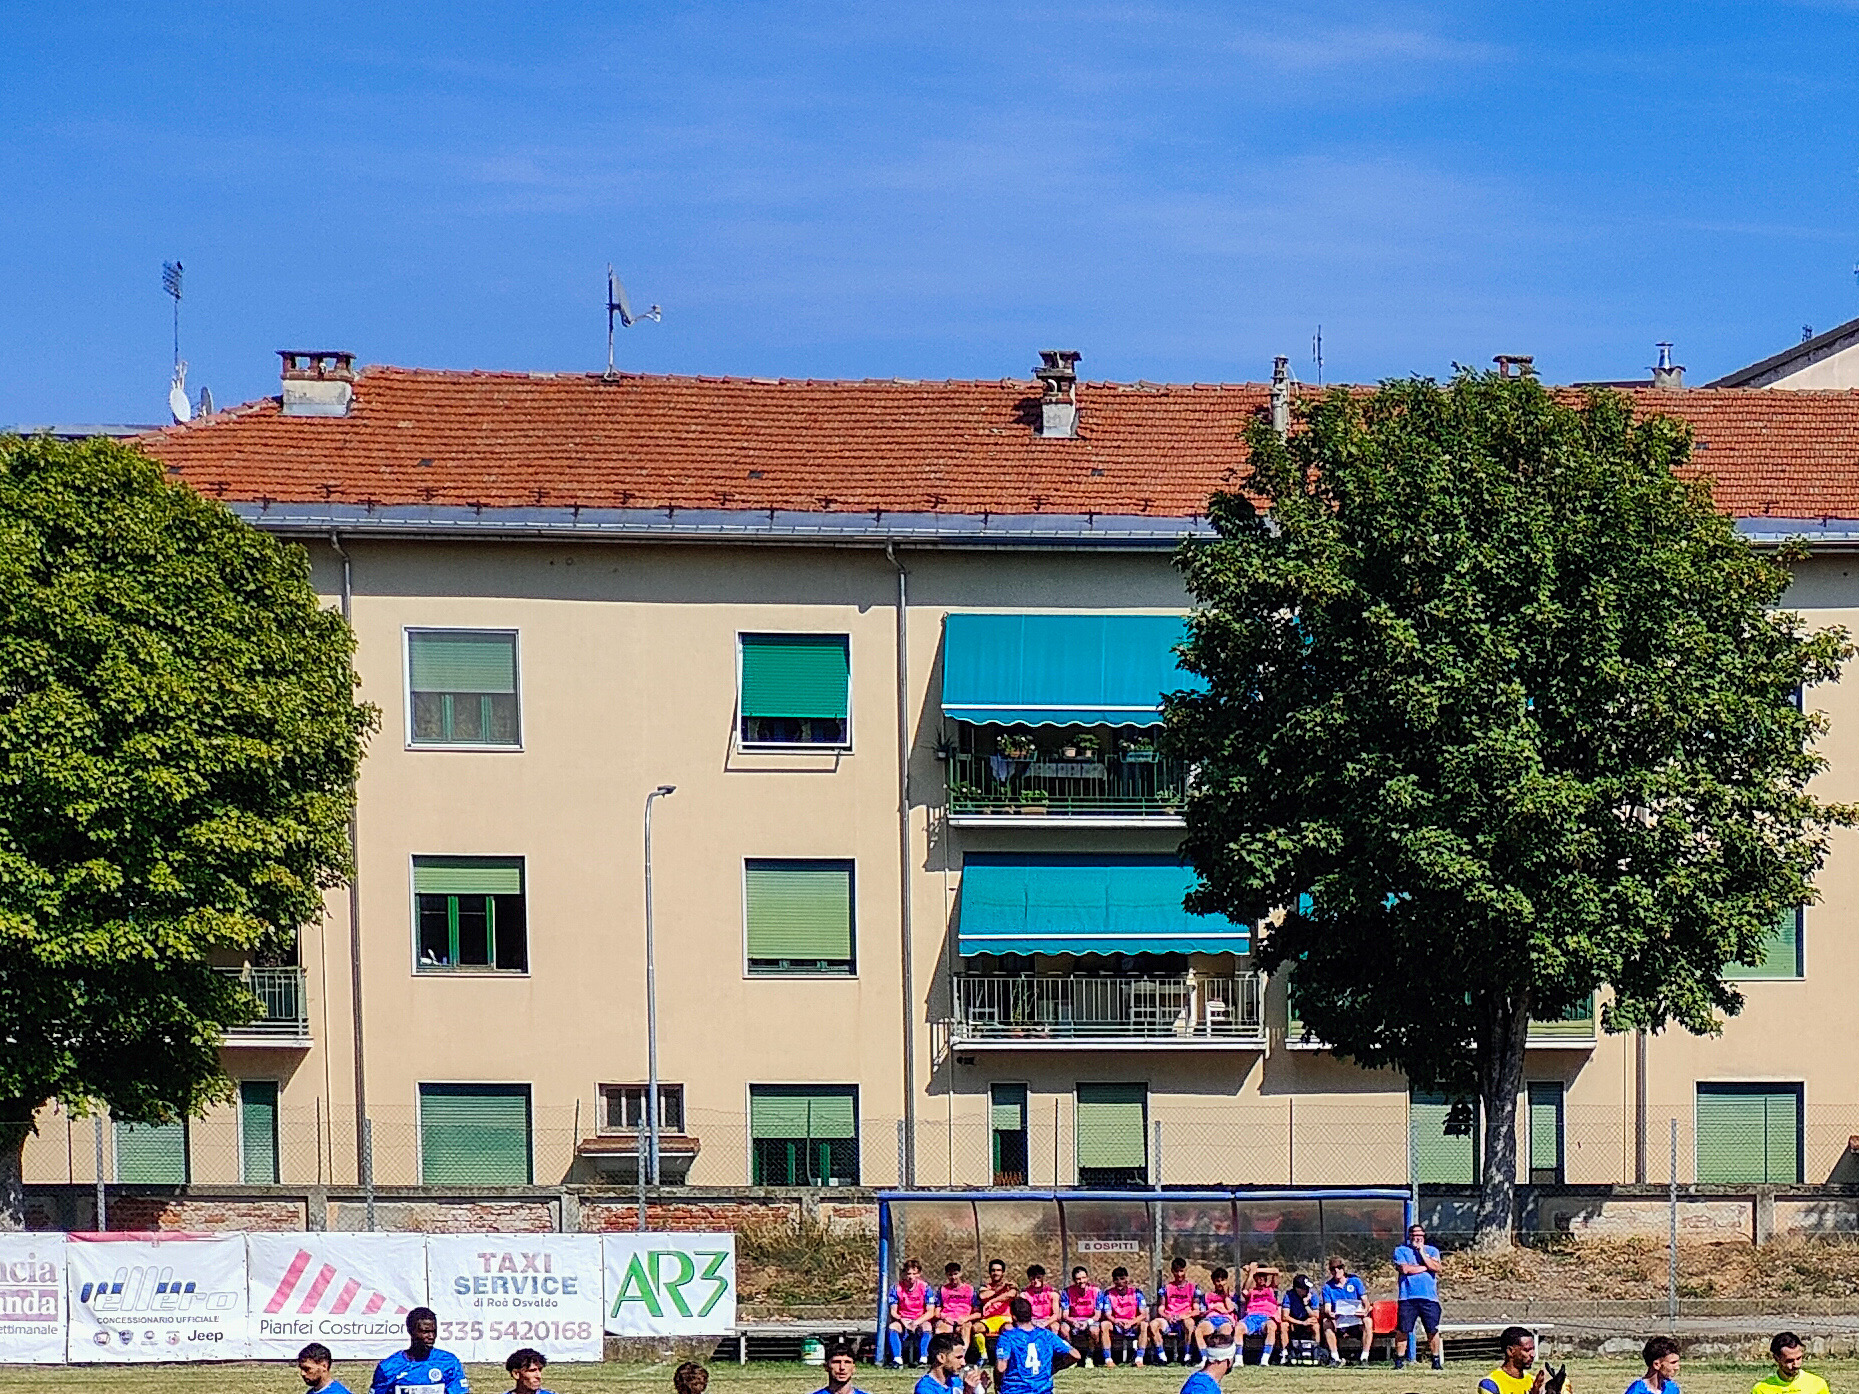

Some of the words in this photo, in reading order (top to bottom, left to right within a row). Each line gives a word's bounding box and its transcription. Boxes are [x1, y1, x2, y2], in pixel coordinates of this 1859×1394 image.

[477, 1252, 552, 1273] TAXI
[454, 1276, 578, 1295] SERVICE
[610, 1250, 729, 1318] AR3
[474, 1298, 484, 1307] di
[512, 1298, 558, 1308] Osvaldo
[97, 1317, 174, 1325] CONCESSIONARIO
[176, 1315, 220, 1324] UFFICIALE
[260, 1320, 313, 1334] Pianfei
[319, 1320, 406, 1335] Costruzion
[188, 1330, 223, 1342] Jeep
[439, 1321, 485, 1341] 335
[489, 1321, 592, 1341] 5420168
[1025, 1343, 1041, 1375] 4
